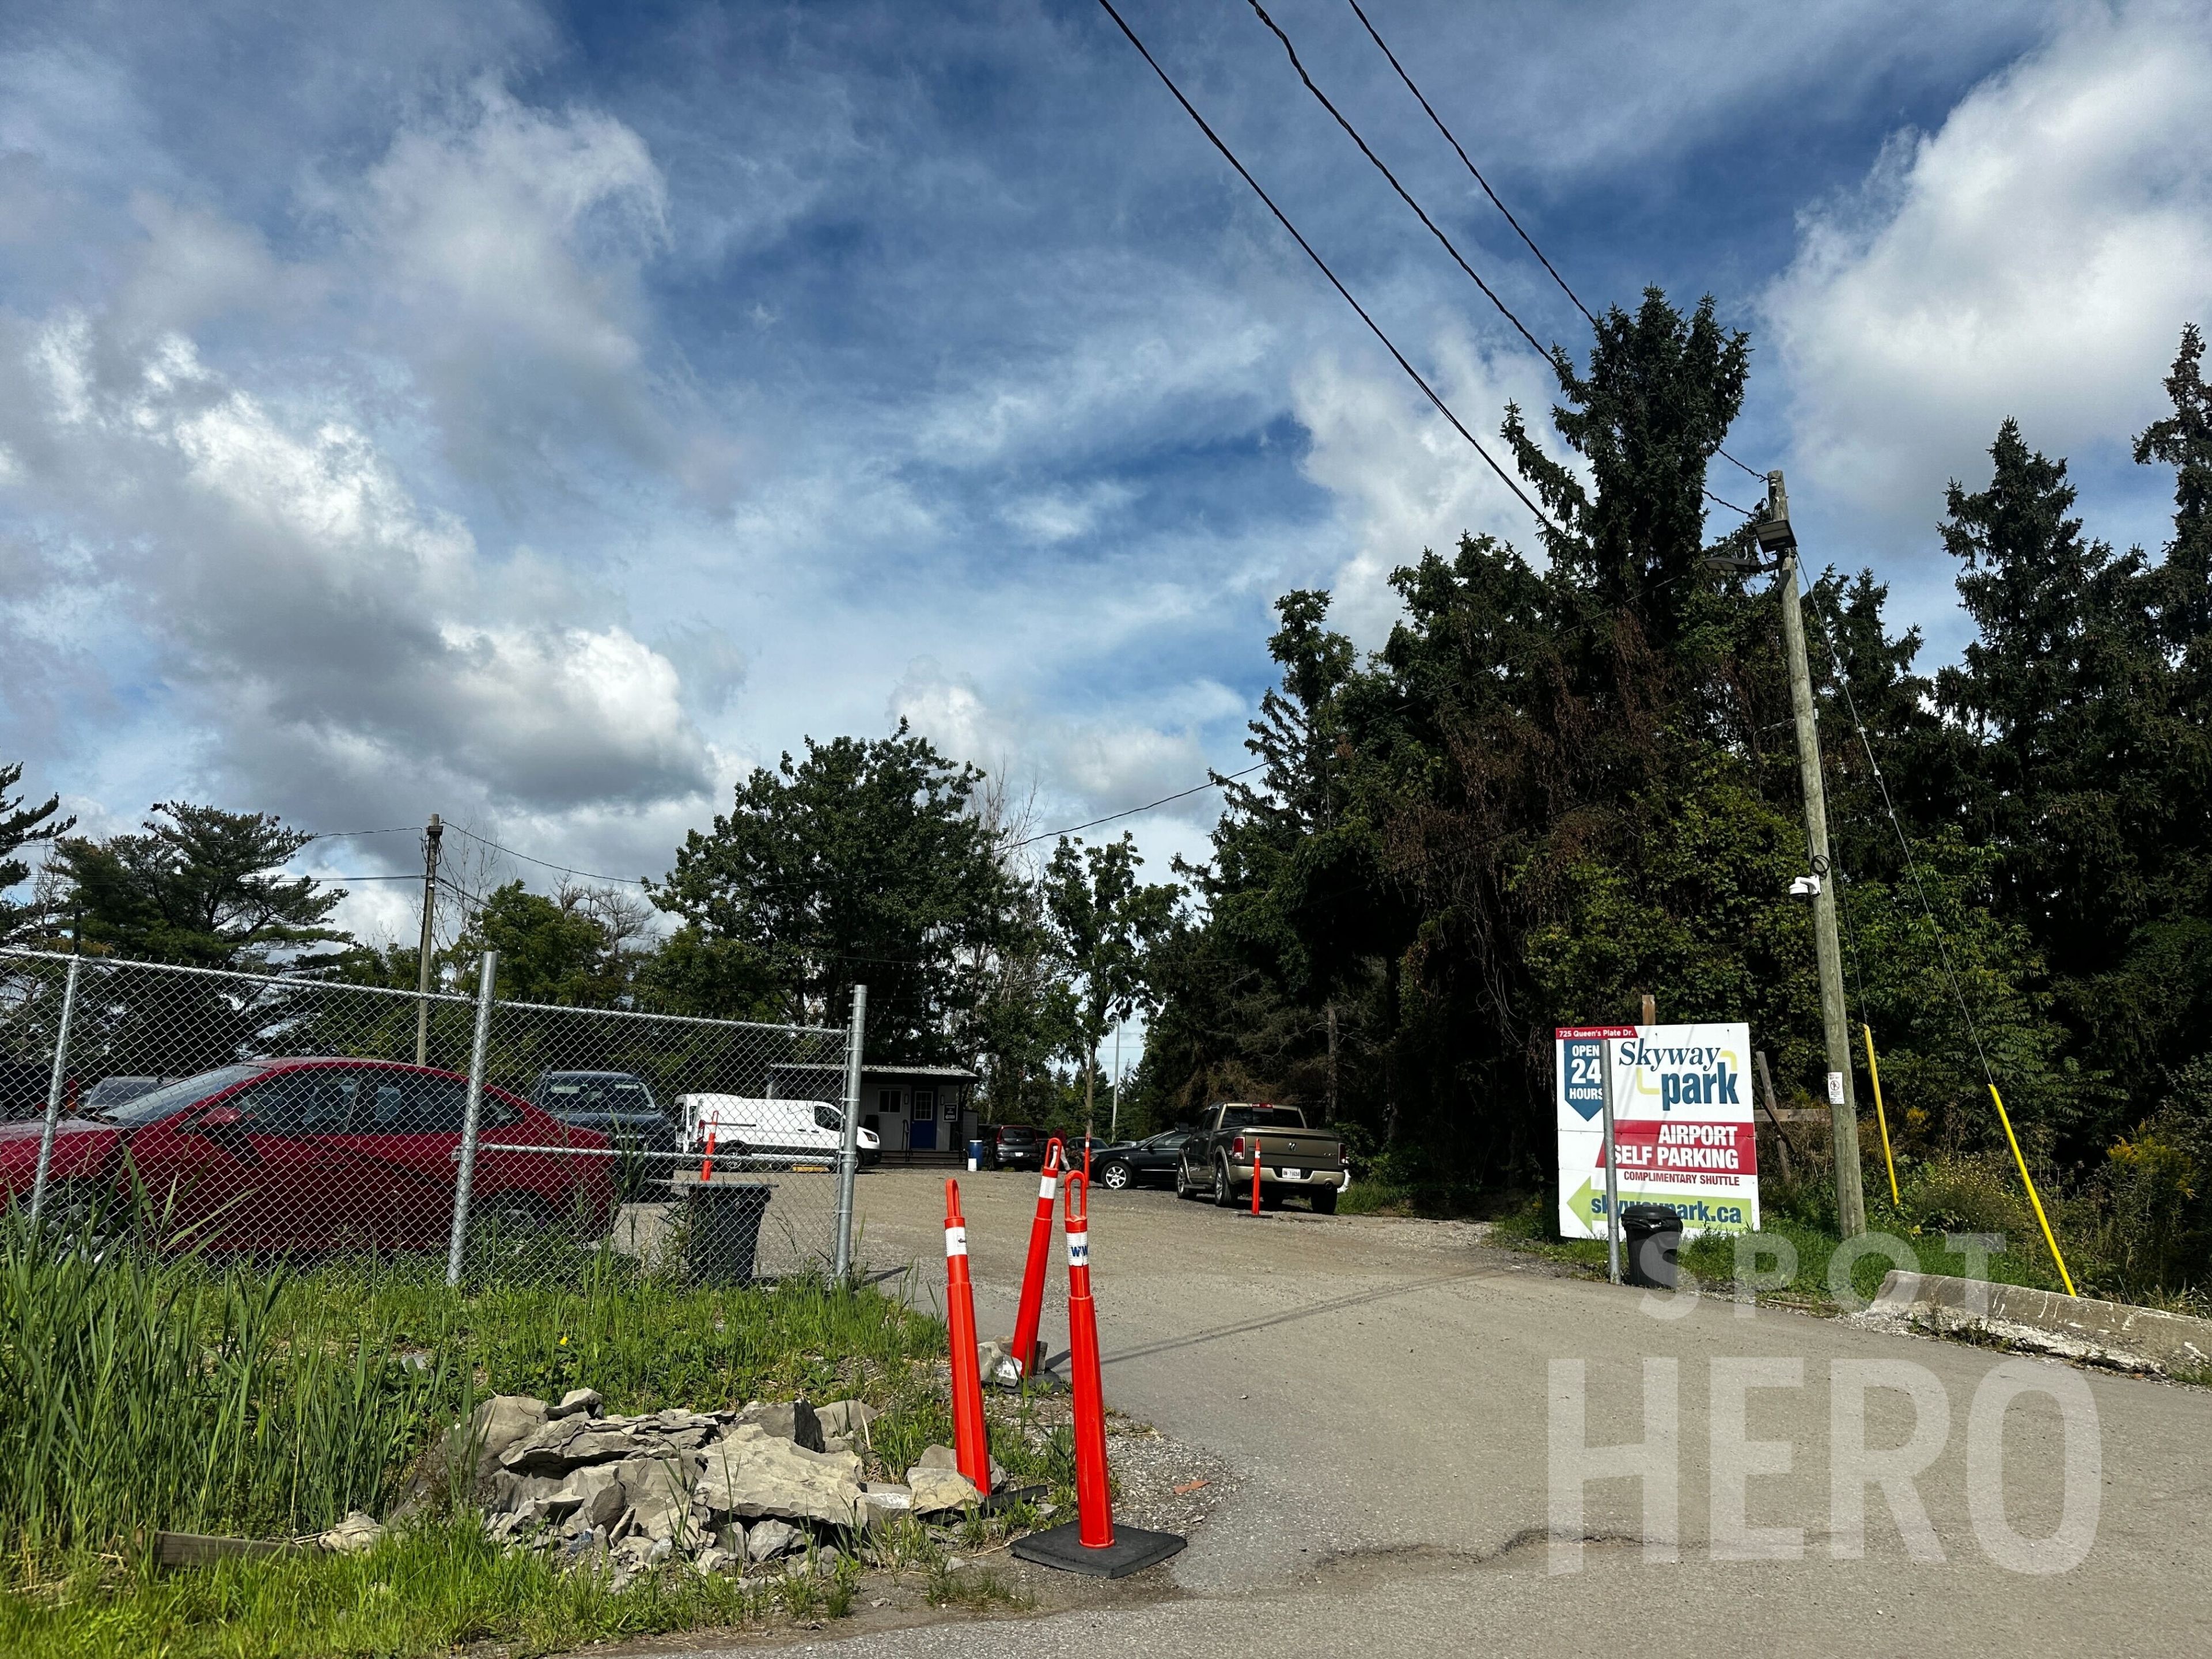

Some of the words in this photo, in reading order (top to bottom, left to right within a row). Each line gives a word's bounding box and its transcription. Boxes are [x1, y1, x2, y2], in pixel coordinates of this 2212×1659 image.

[1571, 1044, 1600, 1057] OPEN
[1619, 1038, 1721, 1072] Skyway
[1571, 1058, 1602, 1084] 24
[1569, 1088, 1603, 1100] HOURS
[1661, 1062, 1740, 1111] park
[1658, 1124, 1738, 1146] AIRPORT
[1614, 1144, 1652, 1165] SELF
[1657, 1146, 1739, 1169] PARKING
[1624, 1171, 1697, 1184] COMPLIMENTARY
[1700, 1175, 1740, 1186] SHUTTLE
